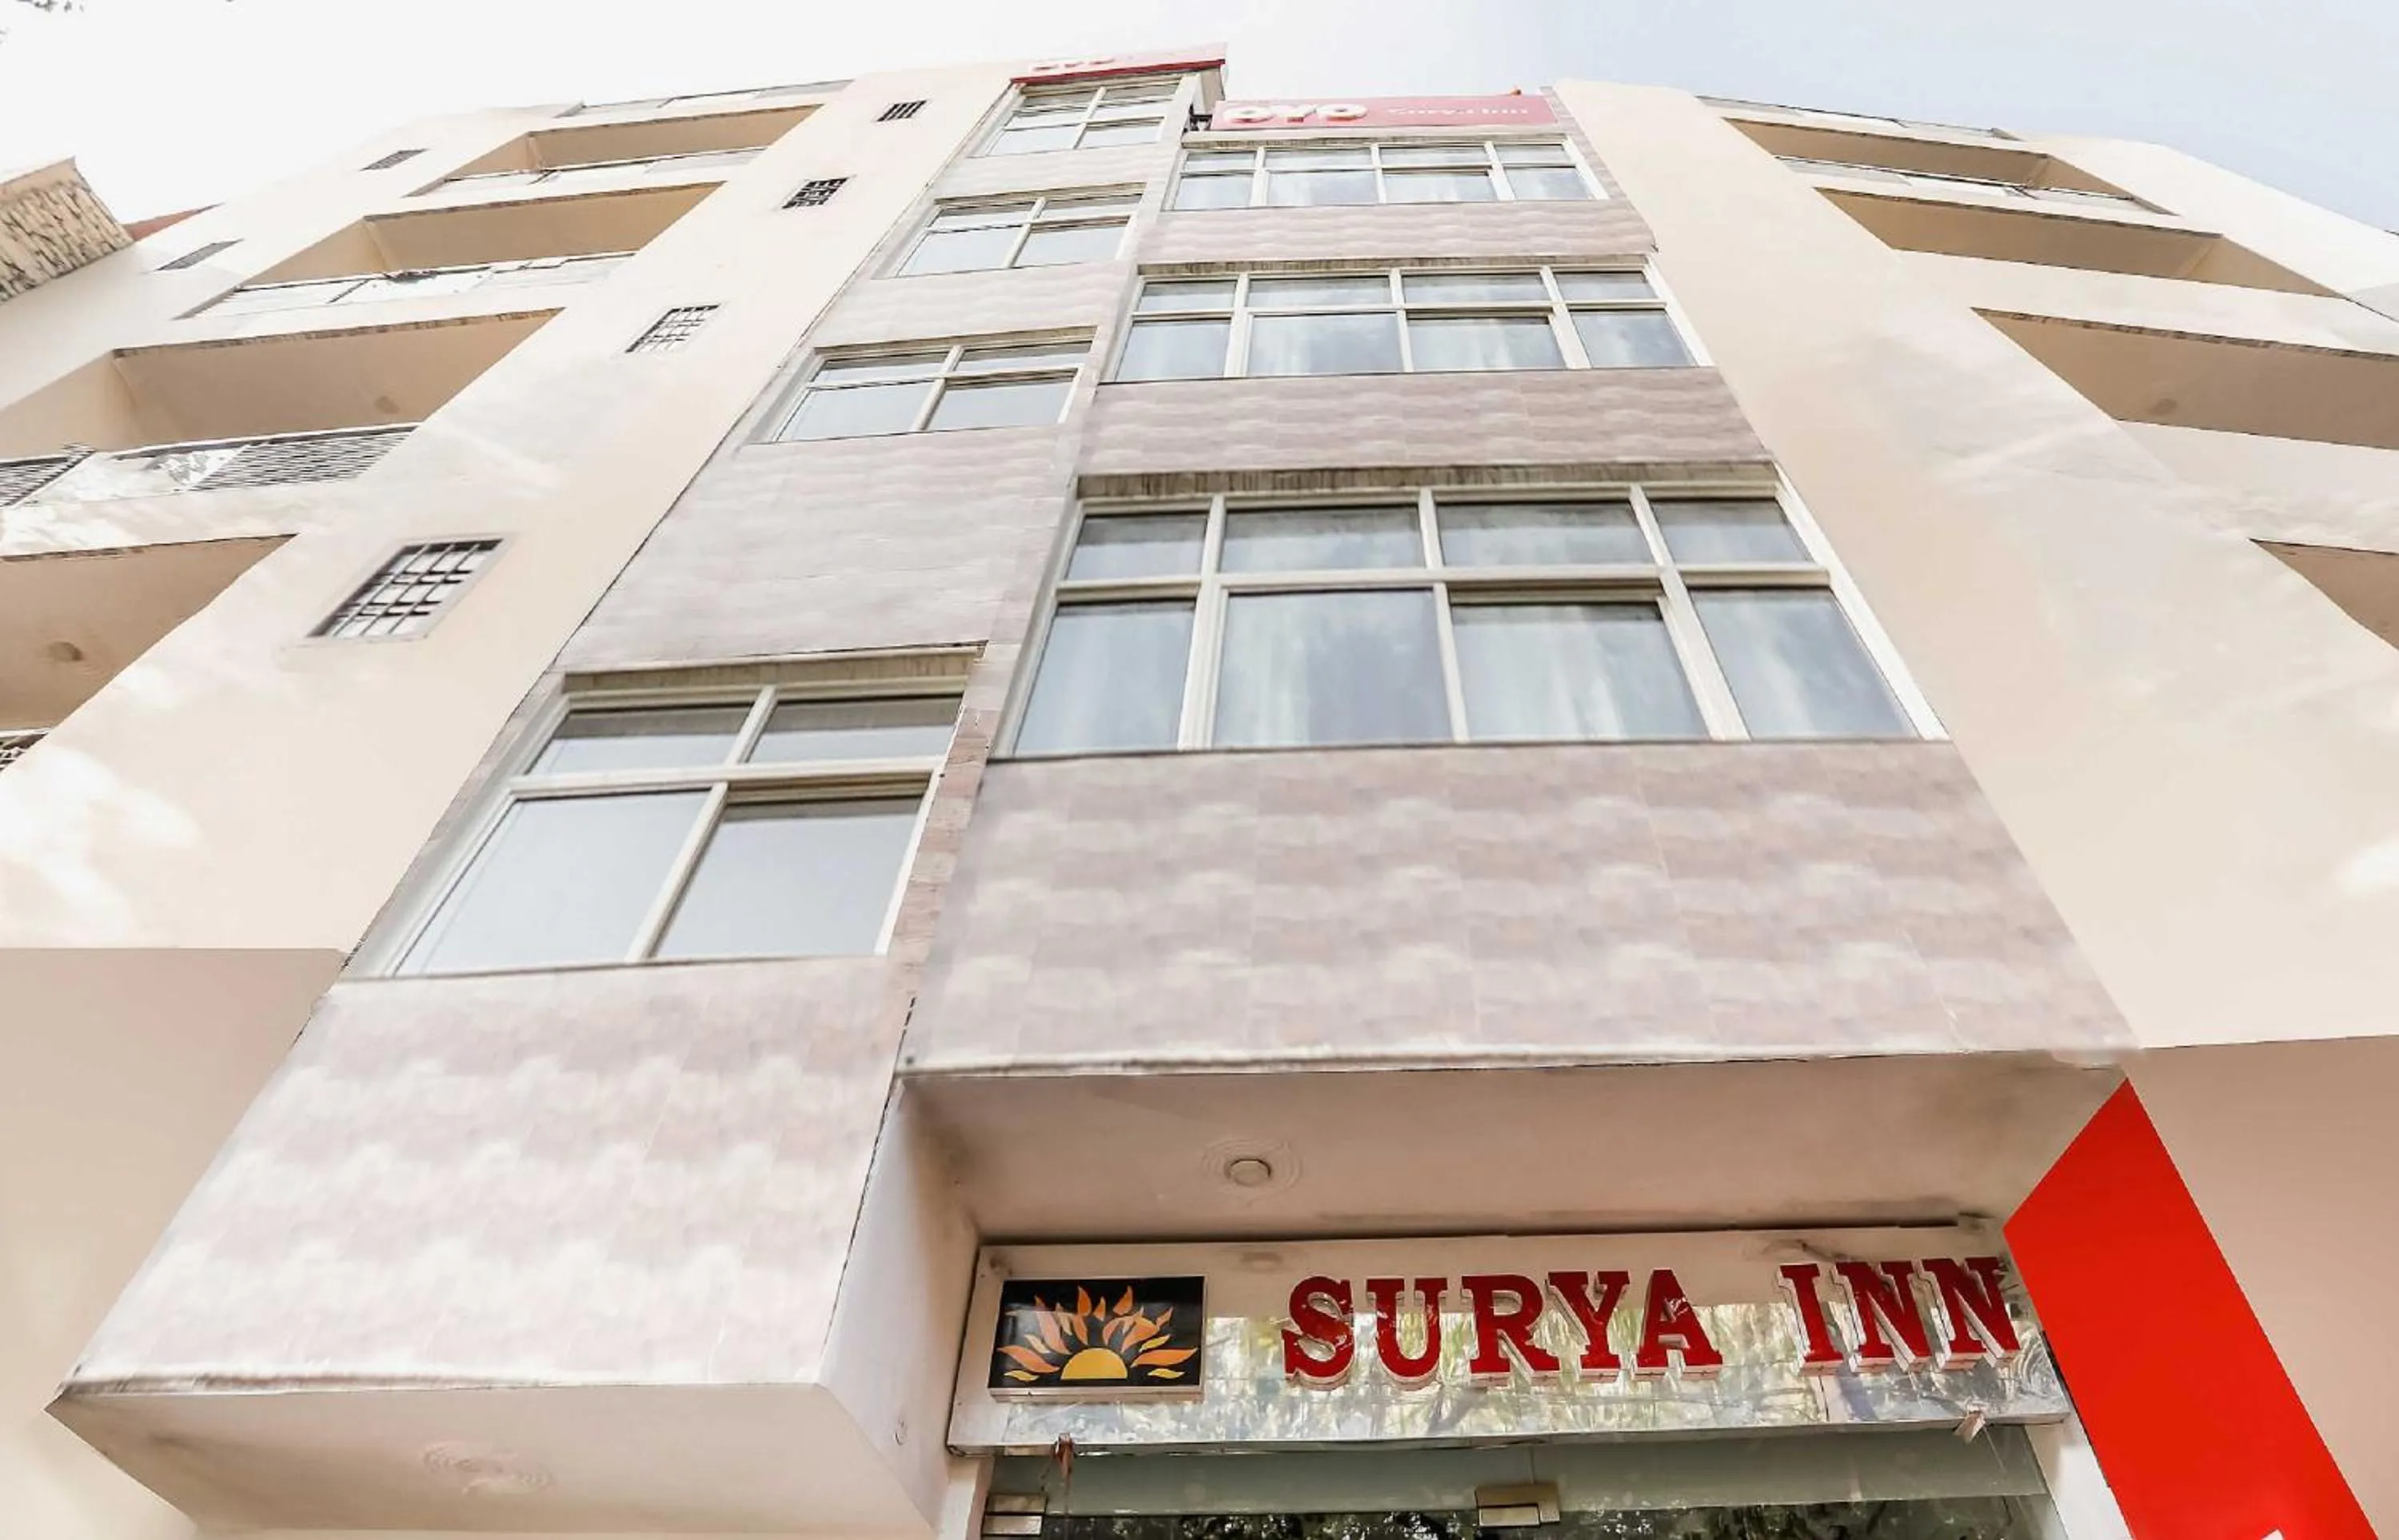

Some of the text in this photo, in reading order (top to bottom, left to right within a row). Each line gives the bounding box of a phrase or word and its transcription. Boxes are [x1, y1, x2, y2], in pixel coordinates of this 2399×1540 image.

[1223, 102, 1368, 122] OYO
[1281, 1256, 2022, 1386] SURYA INN
